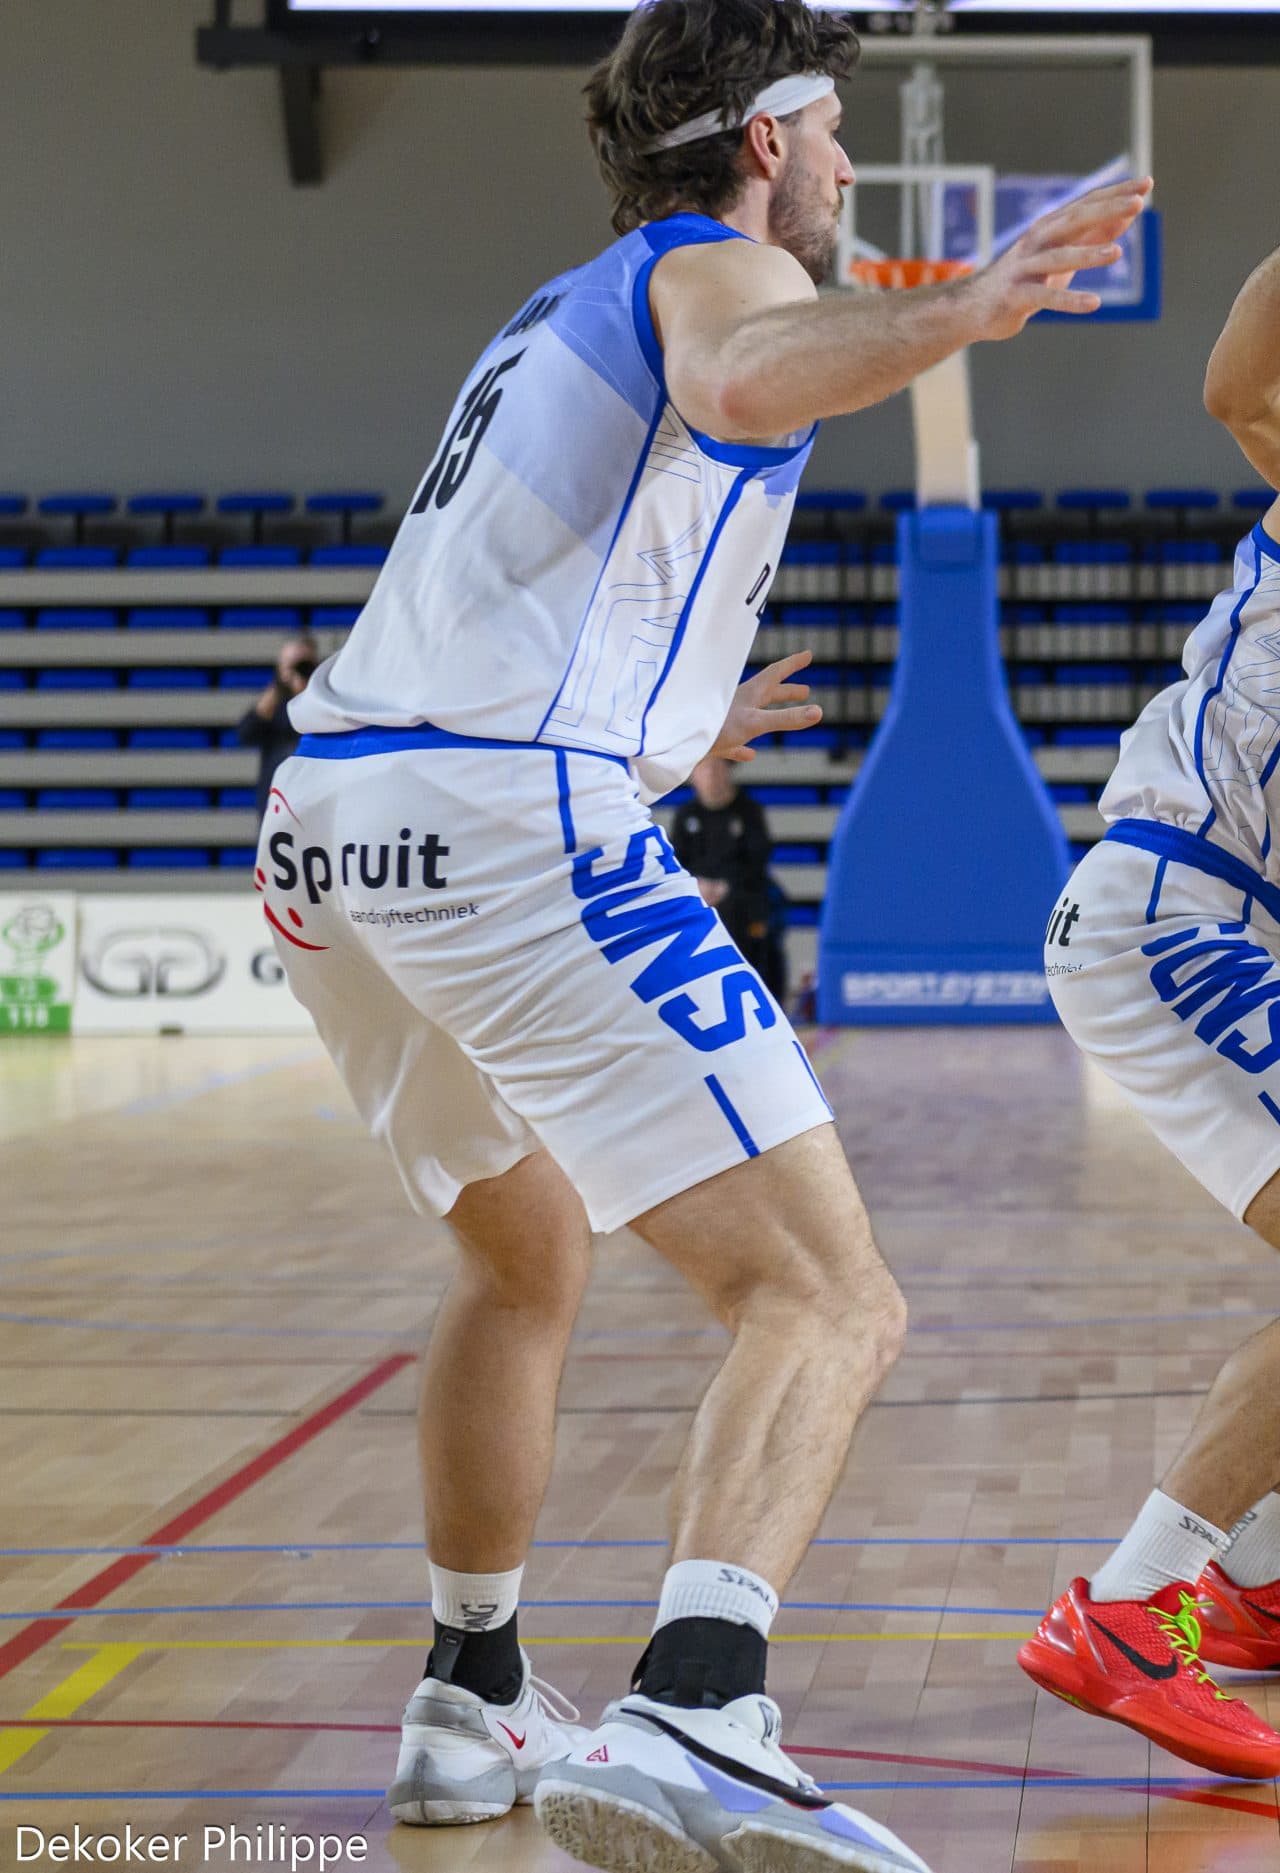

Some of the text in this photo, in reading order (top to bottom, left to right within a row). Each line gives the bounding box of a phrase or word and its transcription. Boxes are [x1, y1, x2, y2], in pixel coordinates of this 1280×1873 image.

[410, 345, 529, 515] 15
[269, 827, 450, 905] Spruit
[350, 903, 480, 928] aandrijftechniek
[571, 824, 776, 1053] SUNS
